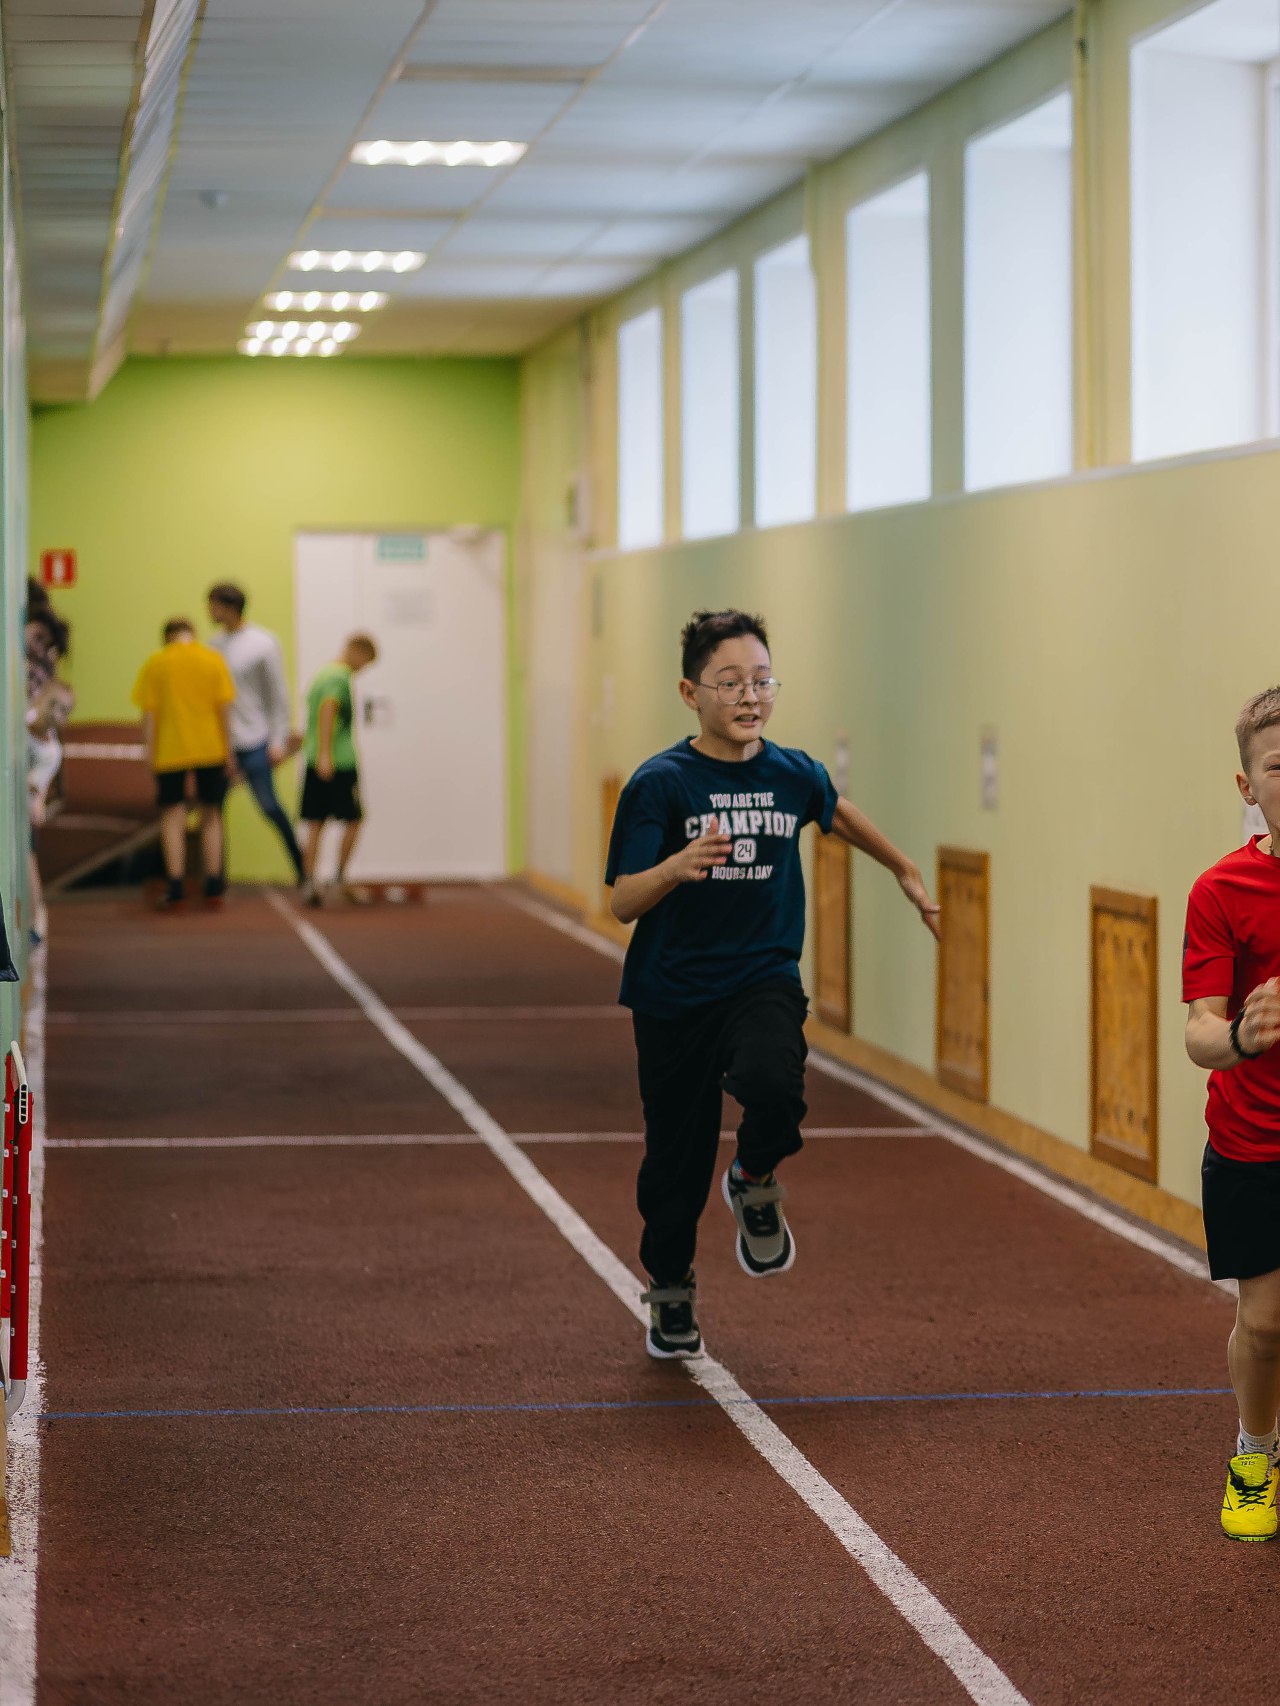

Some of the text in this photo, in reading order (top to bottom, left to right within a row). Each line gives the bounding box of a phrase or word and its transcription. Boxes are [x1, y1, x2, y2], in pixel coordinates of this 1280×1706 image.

[709, 792, 774, 808] YOU ARE THE
[737, 843, 752, 858] 24
[712, 865, 773, 880] HOURS A DAY
